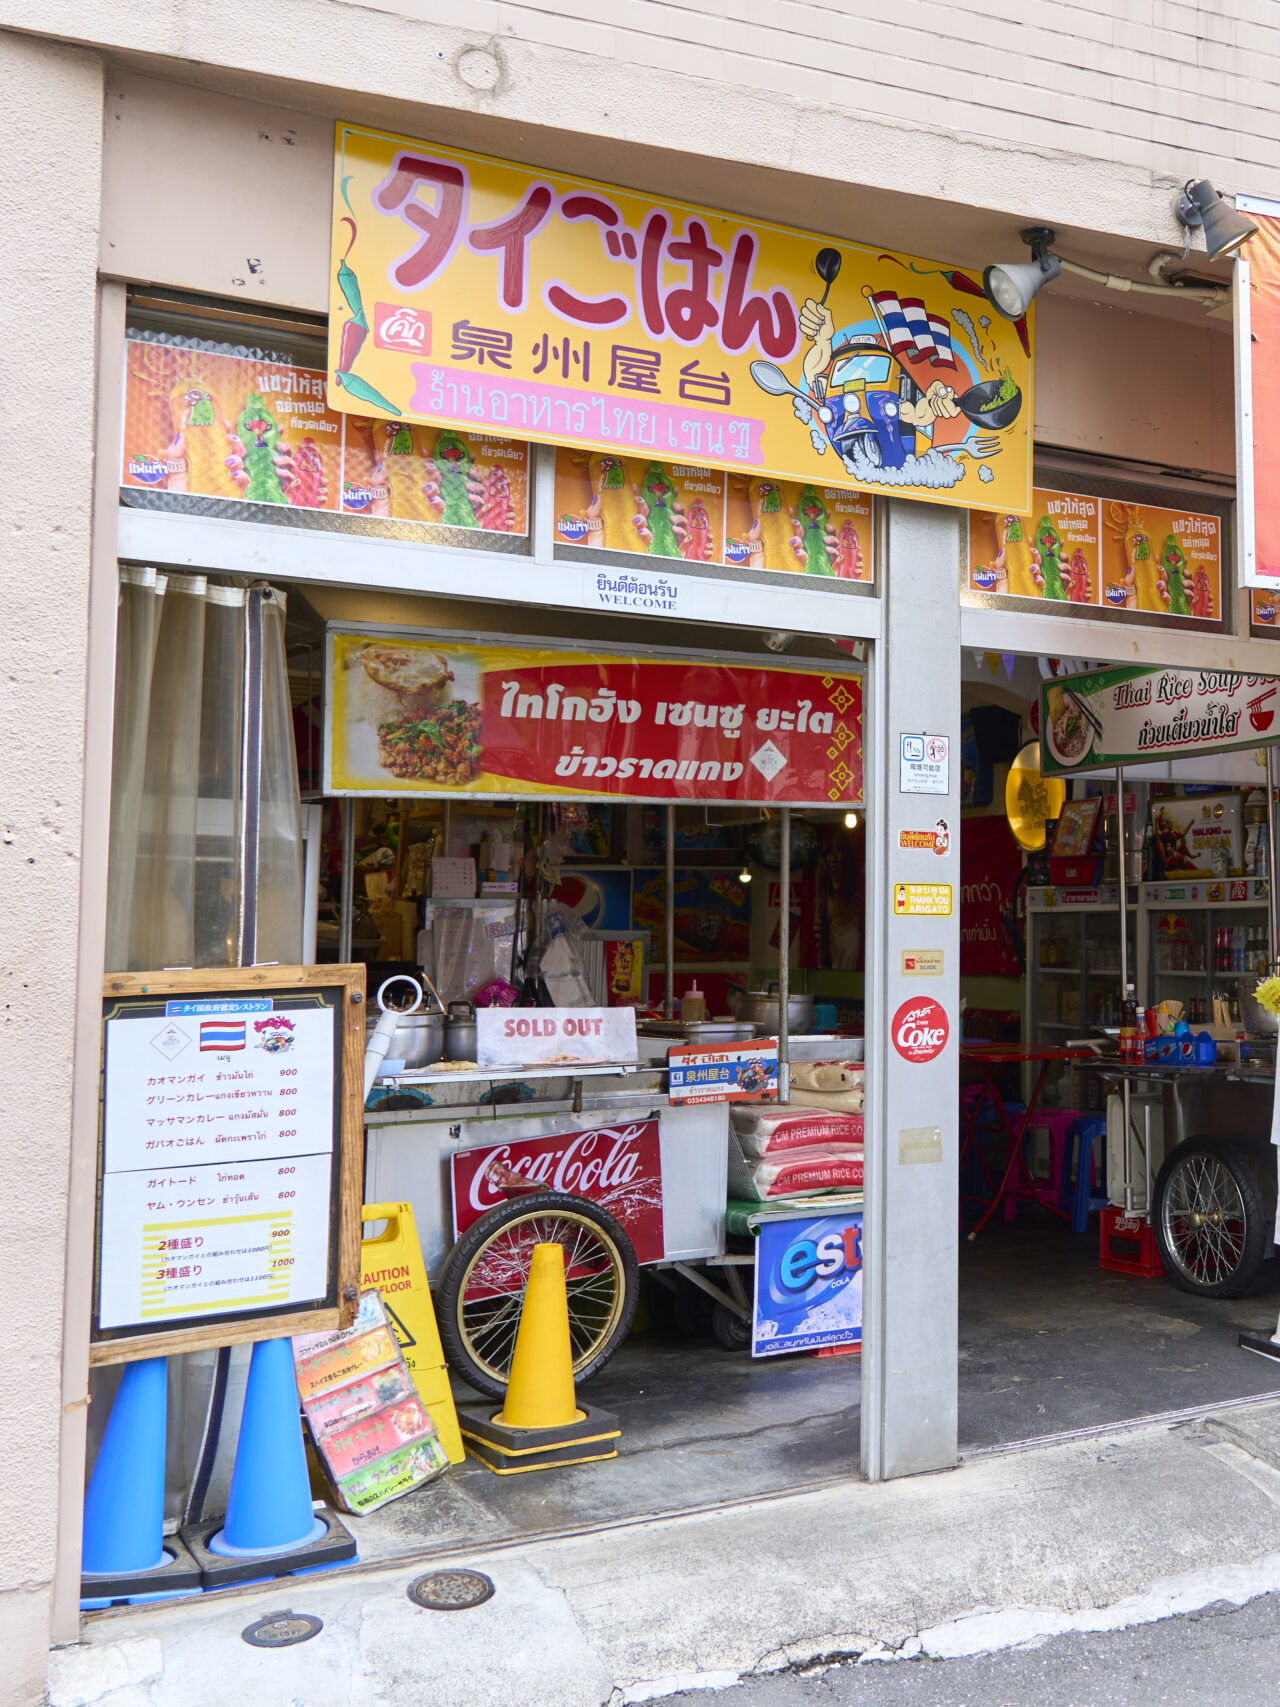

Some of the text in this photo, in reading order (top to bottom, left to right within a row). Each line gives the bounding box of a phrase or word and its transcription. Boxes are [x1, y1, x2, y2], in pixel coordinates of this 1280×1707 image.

[376, 154, 801, 359] タイごはん
[450, 319, 731, 406] 泉州屋台
[430, 369, 656, 445] ร้านอาหารไทย
[596, 573, 678, 599] ยินดีต้อนรับ
[598, 592, 678, 611] WELCOME
[1113, 680, 1150, 708] Thai
[1157, 672, 1191, 701] Rice
[654, 699, 745, 739] เซนซู
[1138, 701, 1241, 749] ก๋วยเตี๋ยวน้ำใส
[555, 746, 744, 782] ข้าวราดแกง
[908, 905, 950, 914] ARIGATO
[909, 896, 950, 906] THANK YOU
[504, 1018, 603, 1038] SOLD OUT
[897, 1022, 945, 1047] Coke
[147, 1073, 206, 1087] カオマンガイ
[279, 1068, 298, 1077] 900
[686, 1068, 730, 1083] 泉州屋台
[146, 1092, 215, 1106] グリーンカレー
[279, 1087, 298, 1096] 800
[146, 1113, 225, 1127] マッサマンカレー
[278, 1108, 297, 1117] 800
[278, 1129, 297, 1138] 800
[775, 1128, 789, 1143] CM
[790, 1124, 829, 1140] PREMIUM
[830, 1124, 850, 1137] RICE
[469, 1122, 649, 1212] Coca-Cola
[778, 1172, 790, 1185] CM
[791, 1169, 831, 1184] PREMIUM
[832, 1168, 851, 1181] RICE
[147, 1176, 198, 1189] ガイトード
[277, 1167, 296, 1175] 800
[277, 1190, 296, 1199] 800
[158, 1229, 290, 1252] 2種盛り 900
[156, 1258, 295, 1280] 3種盛り 1000
[780, 1225, 860, 1292] est
[360, 1265, 410, 1285] AUTION
[831, 1276, 850, 1289] COLA
